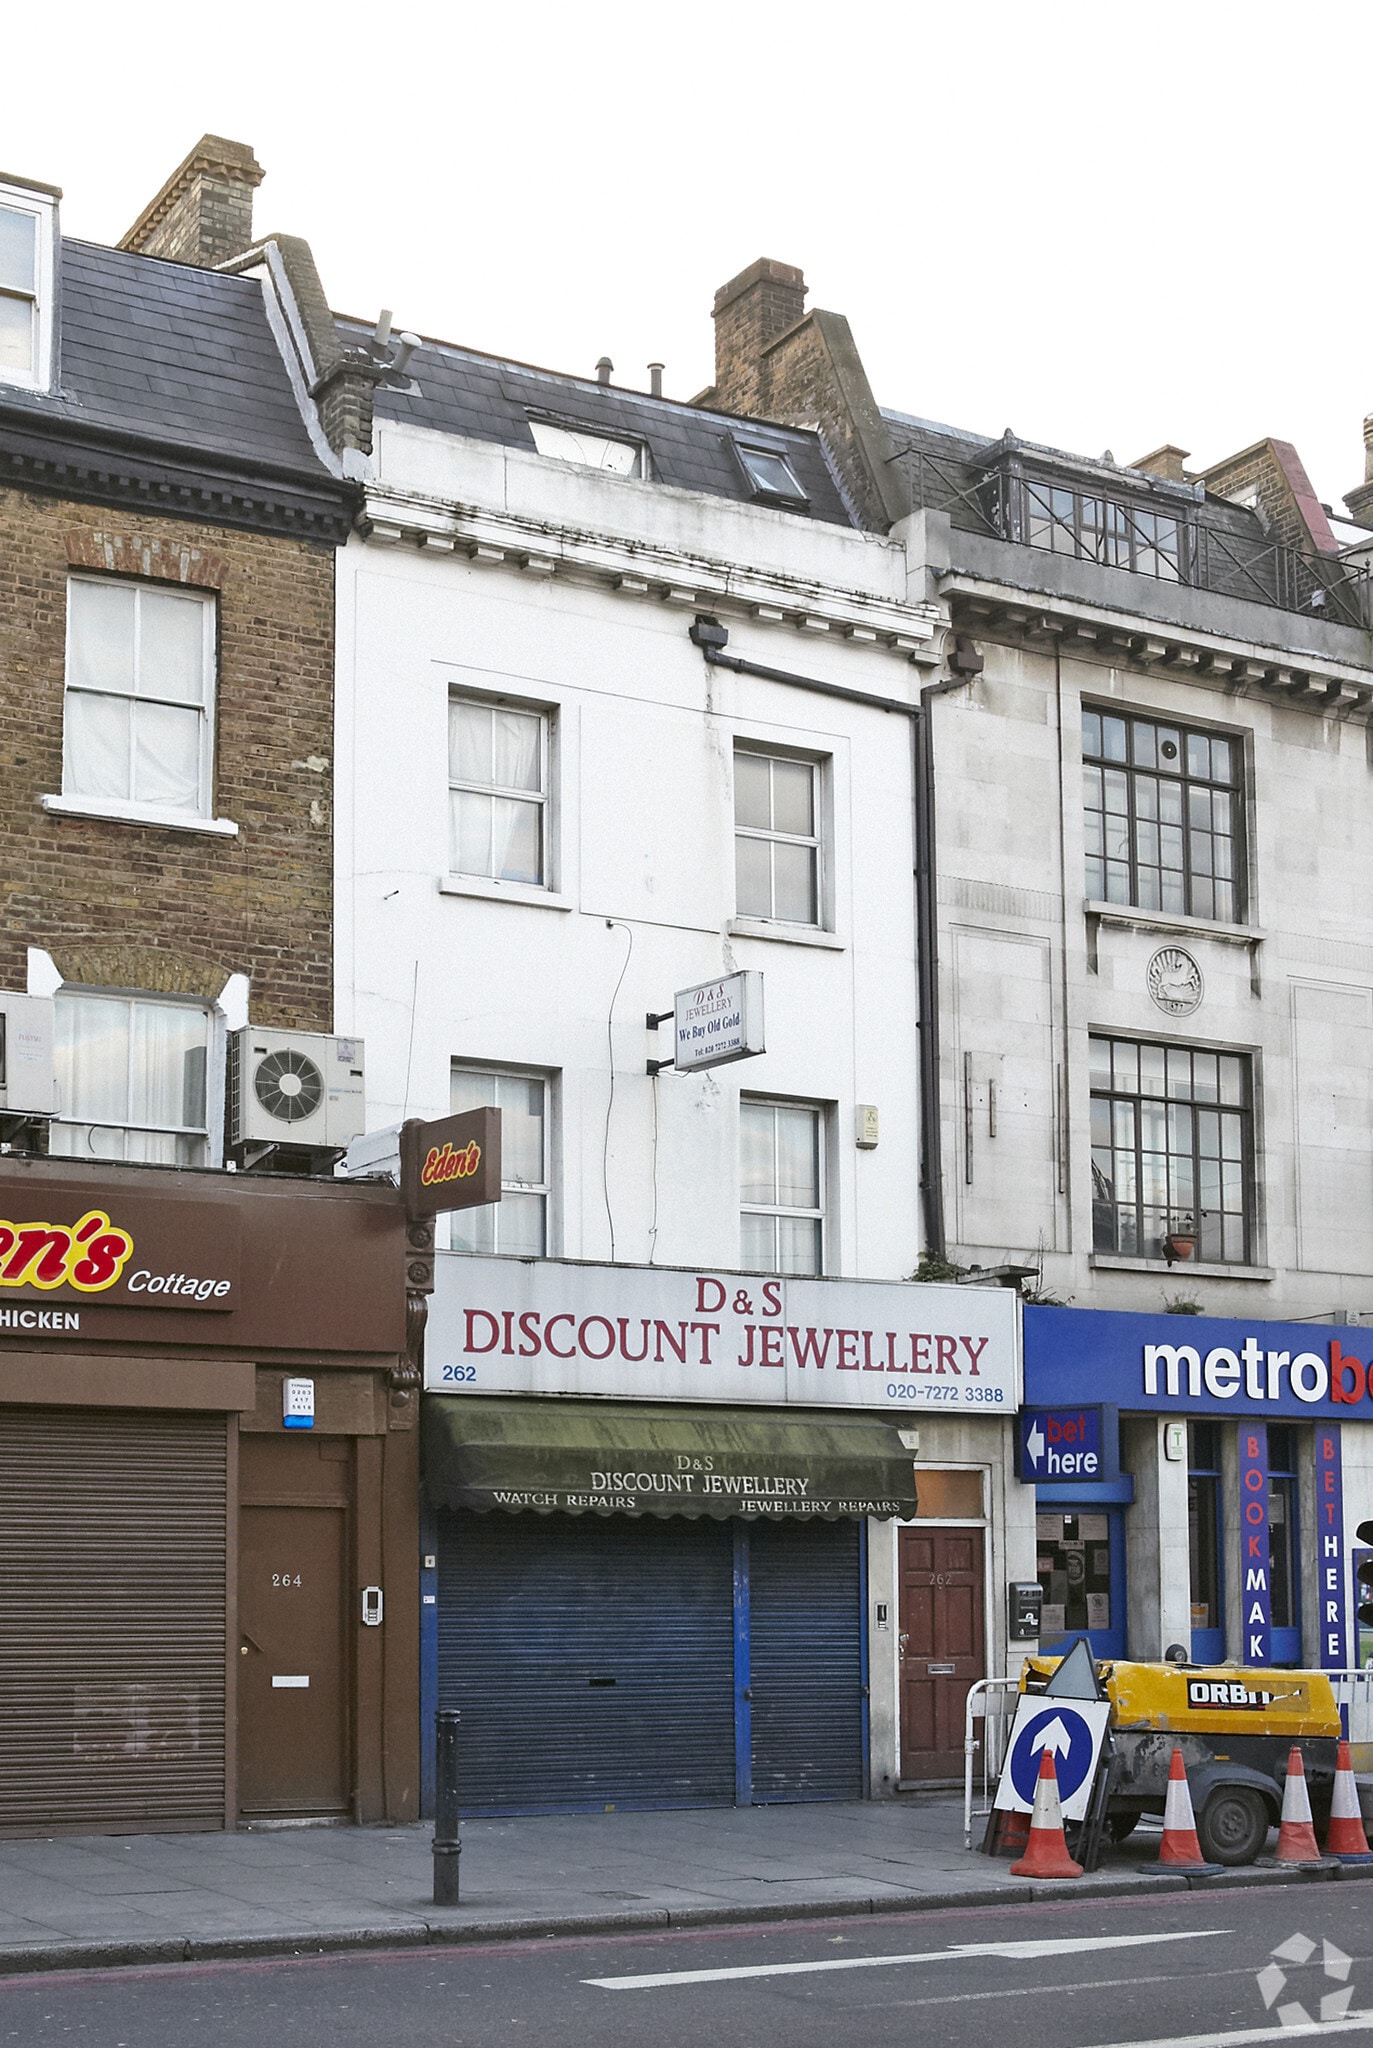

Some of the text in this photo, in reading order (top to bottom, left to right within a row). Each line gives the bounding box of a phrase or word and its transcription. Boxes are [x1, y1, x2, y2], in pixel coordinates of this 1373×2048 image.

[685, 996, 733, 1021] JEWELLERY
[679, 1012, 740, 1042] We Buy Old Gold
[421, 1139, 481, 1186] Eden's
[127, 1270, 232, 1301] Cottage
[462, 1308, 990, 1376] DISCOUNT JEWELLERY
[442, 1364, 477, 1382] 262
[1143, 1337, 1373, 1405] metrob
[886, 1383, 1004, 1403] 020-7272 3388
[1047, 1414, 1086, 1443] bet
[1047, 1447, 1098, 1474] here
[590, 1471, 810, 1496] DISCOUNT JEWELLERY
[493, 1491, 901, 1513] WATCH REPAIRS JEWELLERY REPAIRS
[271, 1573, 303, 1588] 264
[929, 1573, 952, 1585] 262
[1324, 1535, 1339, 1656] HERE
